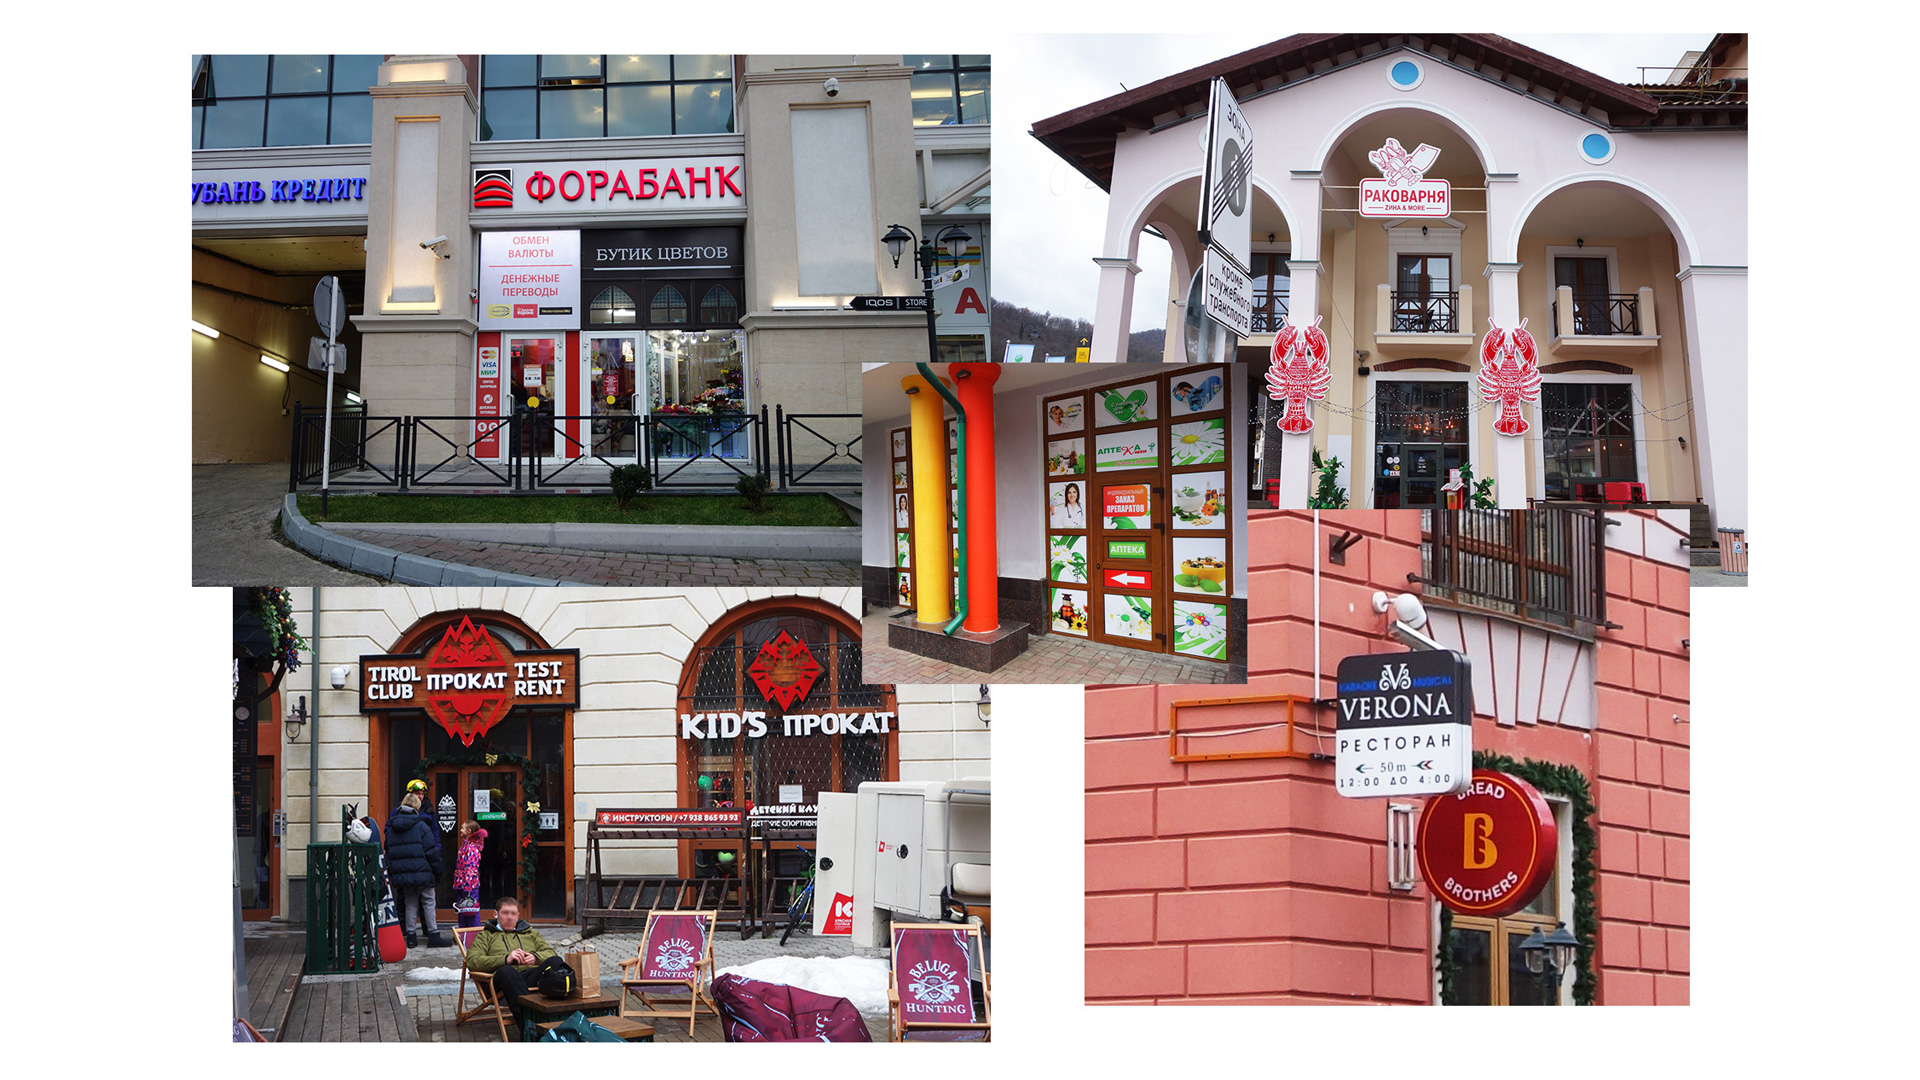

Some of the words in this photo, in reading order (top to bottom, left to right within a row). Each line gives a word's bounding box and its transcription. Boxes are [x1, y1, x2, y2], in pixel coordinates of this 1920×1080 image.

[1227, 104, 1246, 144] ЗОНА
[192, 181, 266, 204] УБАНЬ
[270, 178, 367, 203] КРЕДИТ
[525, 165, 743, 203] ФОРАБАНК
[1364, 189, 1446, 203] РАКОВАРНЯ
[512, 236, 549, 245] ОБМЕН
[508, 249, 554, 258] ВАЛЮТЫ
[596, 248, 652, 261] БУТИК
[657, 246, 729, 261] ЦВЕТОВ
[501, 274, 560, 285] ДЕНЕЖНЫЕ
[1221, 263, 1243, 289] кроме
[502, 287, 558, 298] ПЕРЕВОДЫ
[1209, 274, 1251, 312] служебного
[865, 299, 893, 308] IQOS
[905, 298, 928, 306] STORE
[1210, 294, 1248, 329] транспорта
[1115, 495, 1135, 504] ЗАКАЗ
[1107, 504, 1145, 513] ПРЕПАРАТОВ
[1110, 545, 1145, 554] АПТЕКА
[367, 666, 422, 682] TIROL
[514, 661, 562, 678] TEST
[426, 672, 508, 691] ПРОКАТ
[514, 679, 565, 696] RENT
[1413, 676, 1452, 688] MUSICAL
[367, 684, 414, 700] CLUB
[1340, 692, 1452, 721] VERONA
[680, 711, 767, 739] KID'S
[783, 712, 895, 737] ПРОКАТ
[1340, 734, 1451, 753] РЕСТОРАН
[1340, 777, 1379, 788] 12:00
[1418, 774, 1450, 784] 4:00
[750, 803, 797, 816] ДЕТСКИЙ
[798, 804, 818, 814] КЛУ
[612, 814, 673, 822] ИНСТРУКТОРЫ
[1444, 871, 1518, 902] BROTHERS
[658, 938, 695, 953] BELUGA
[649, 969, 695, 978] HUNTING
[909, 960, 957, 980] BELUGA
[906, 1003, 966, 1014] HUNTING
